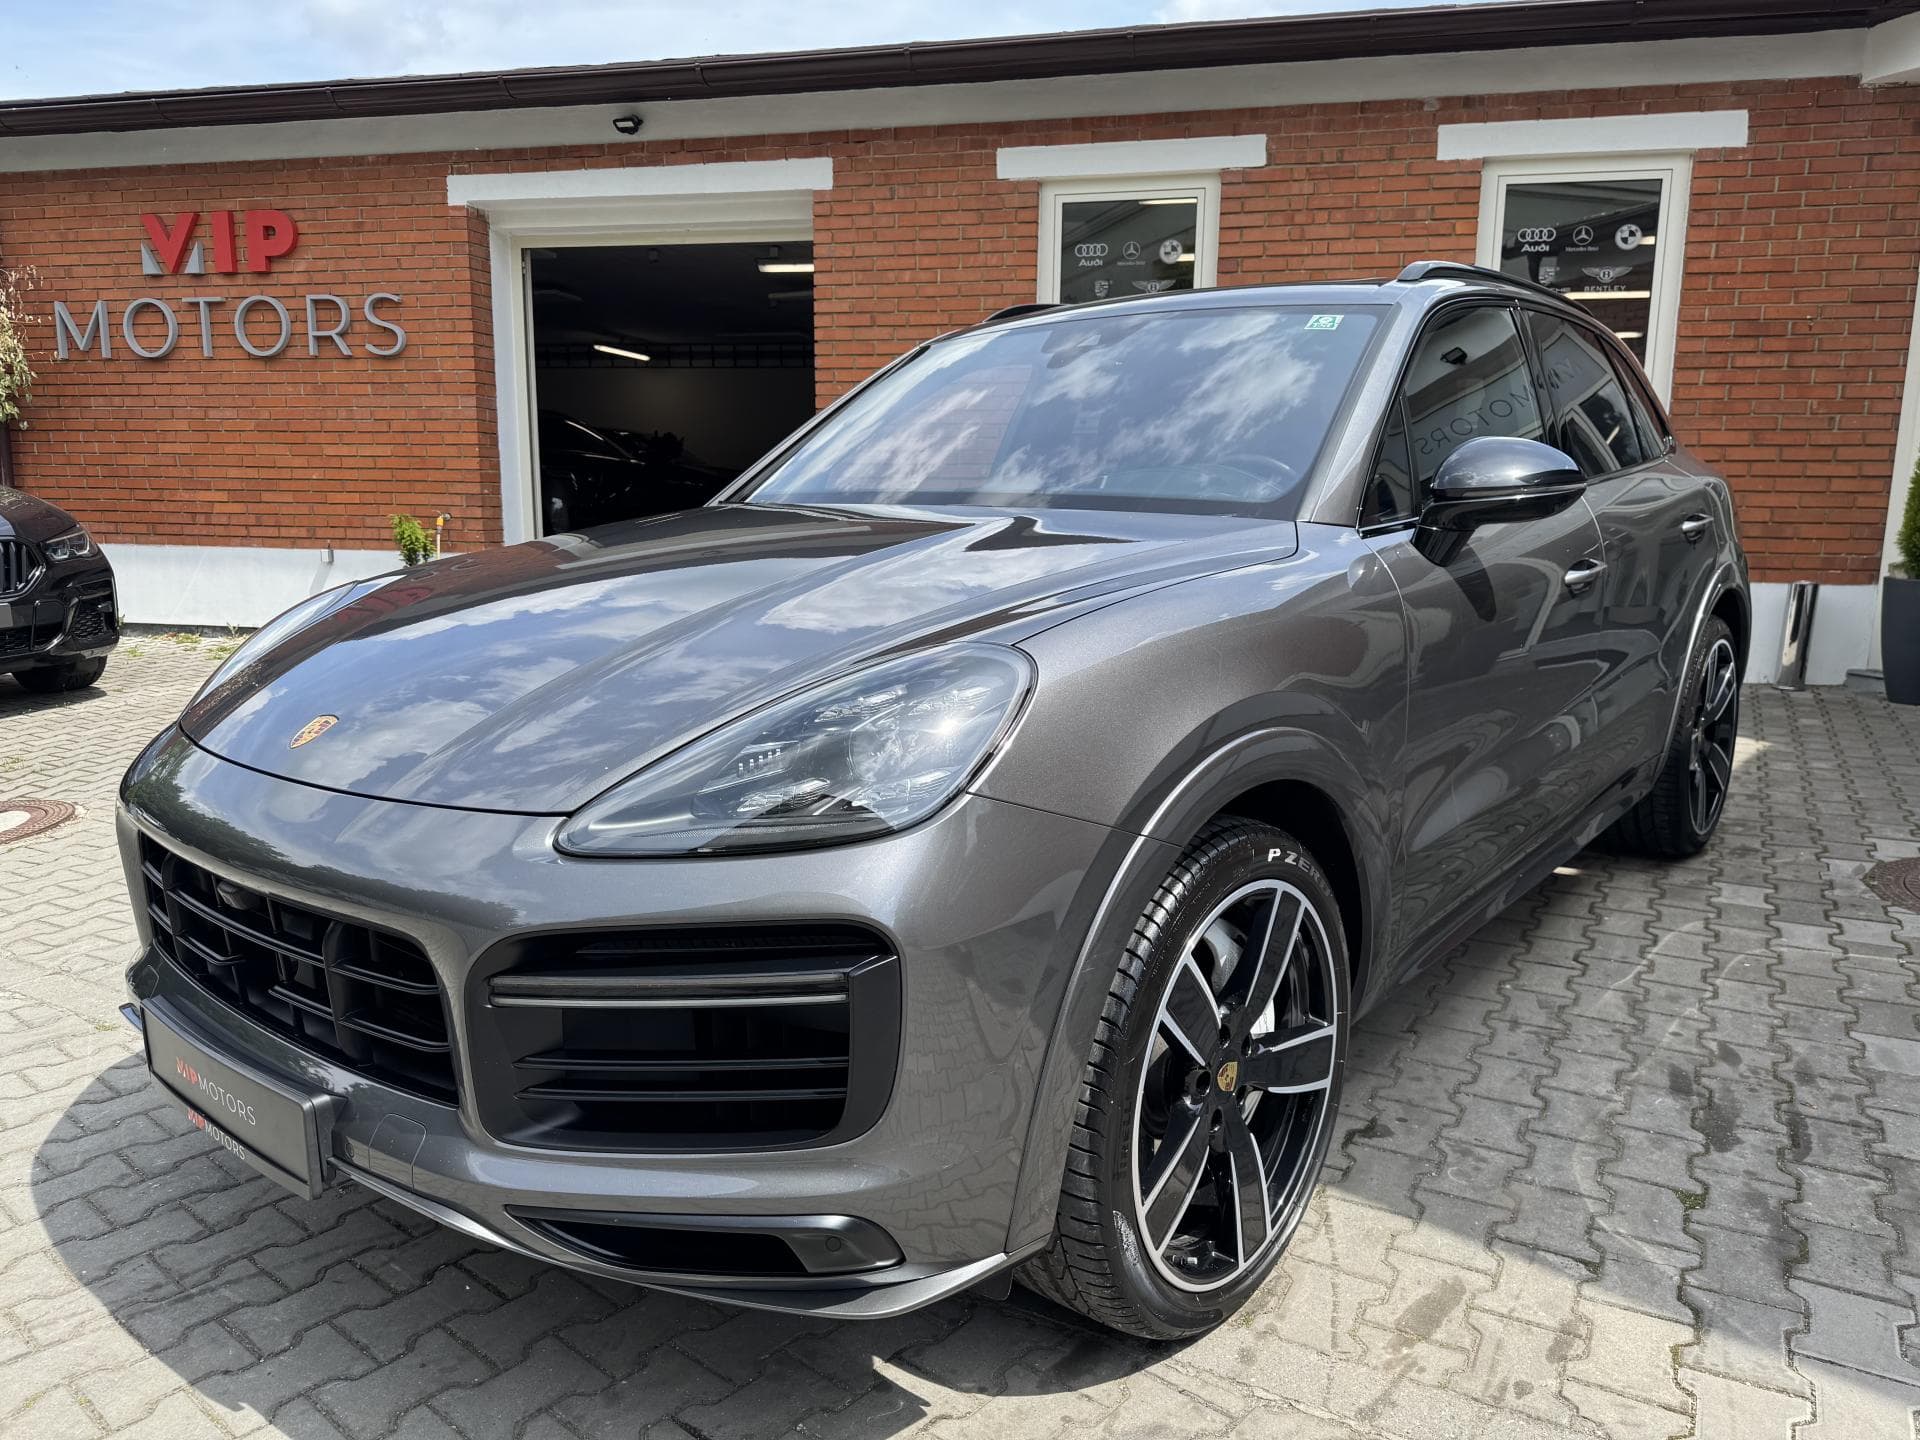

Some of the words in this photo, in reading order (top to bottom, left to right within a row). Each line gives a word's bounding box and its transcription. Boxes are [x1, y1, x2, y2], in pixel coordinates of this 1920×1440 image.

[141, 209, 298, 275] VIP
[1520, 243, 1550, 253] Audi
[1078, 258, 1103, 267] Audi
[54, 293, 407, 360] MOTORS
[1267, 848, 1281, 862] P
